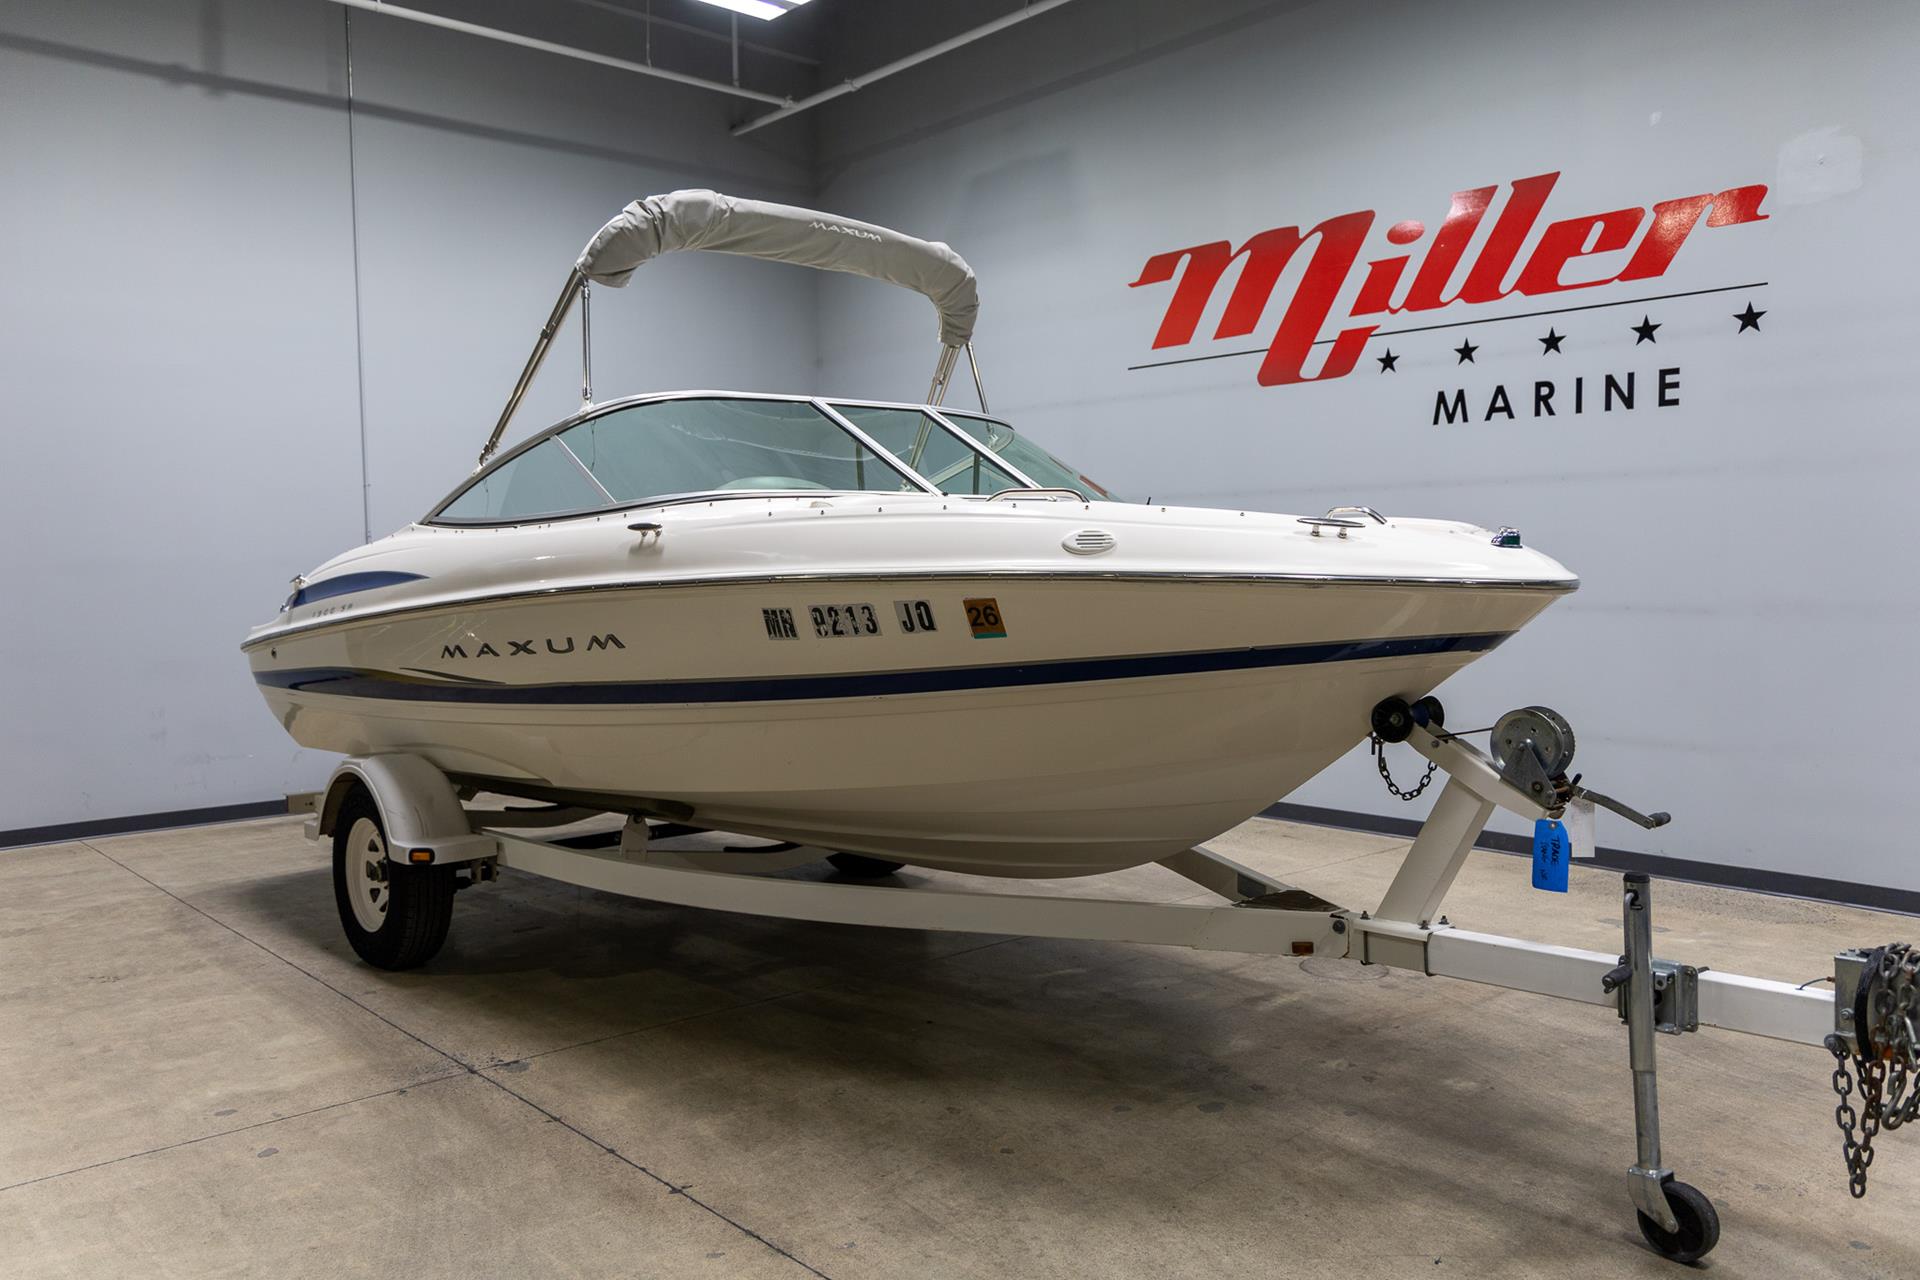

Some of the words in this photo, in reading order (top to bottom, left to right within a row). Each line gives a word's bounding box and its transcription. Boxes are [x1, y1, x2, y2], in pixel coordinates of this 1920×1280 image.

[808, 220, 882, 243] MAXUM
[1128, 171, 1770, 388] Miller
[1432, 367, 1682, 426] MARINE
[762, 609, 798, 638] MN
[902, 601, 937, 632] JQ
[968, 605, 999, 627] 26
[440, 633, 626, 660] MAXUM
